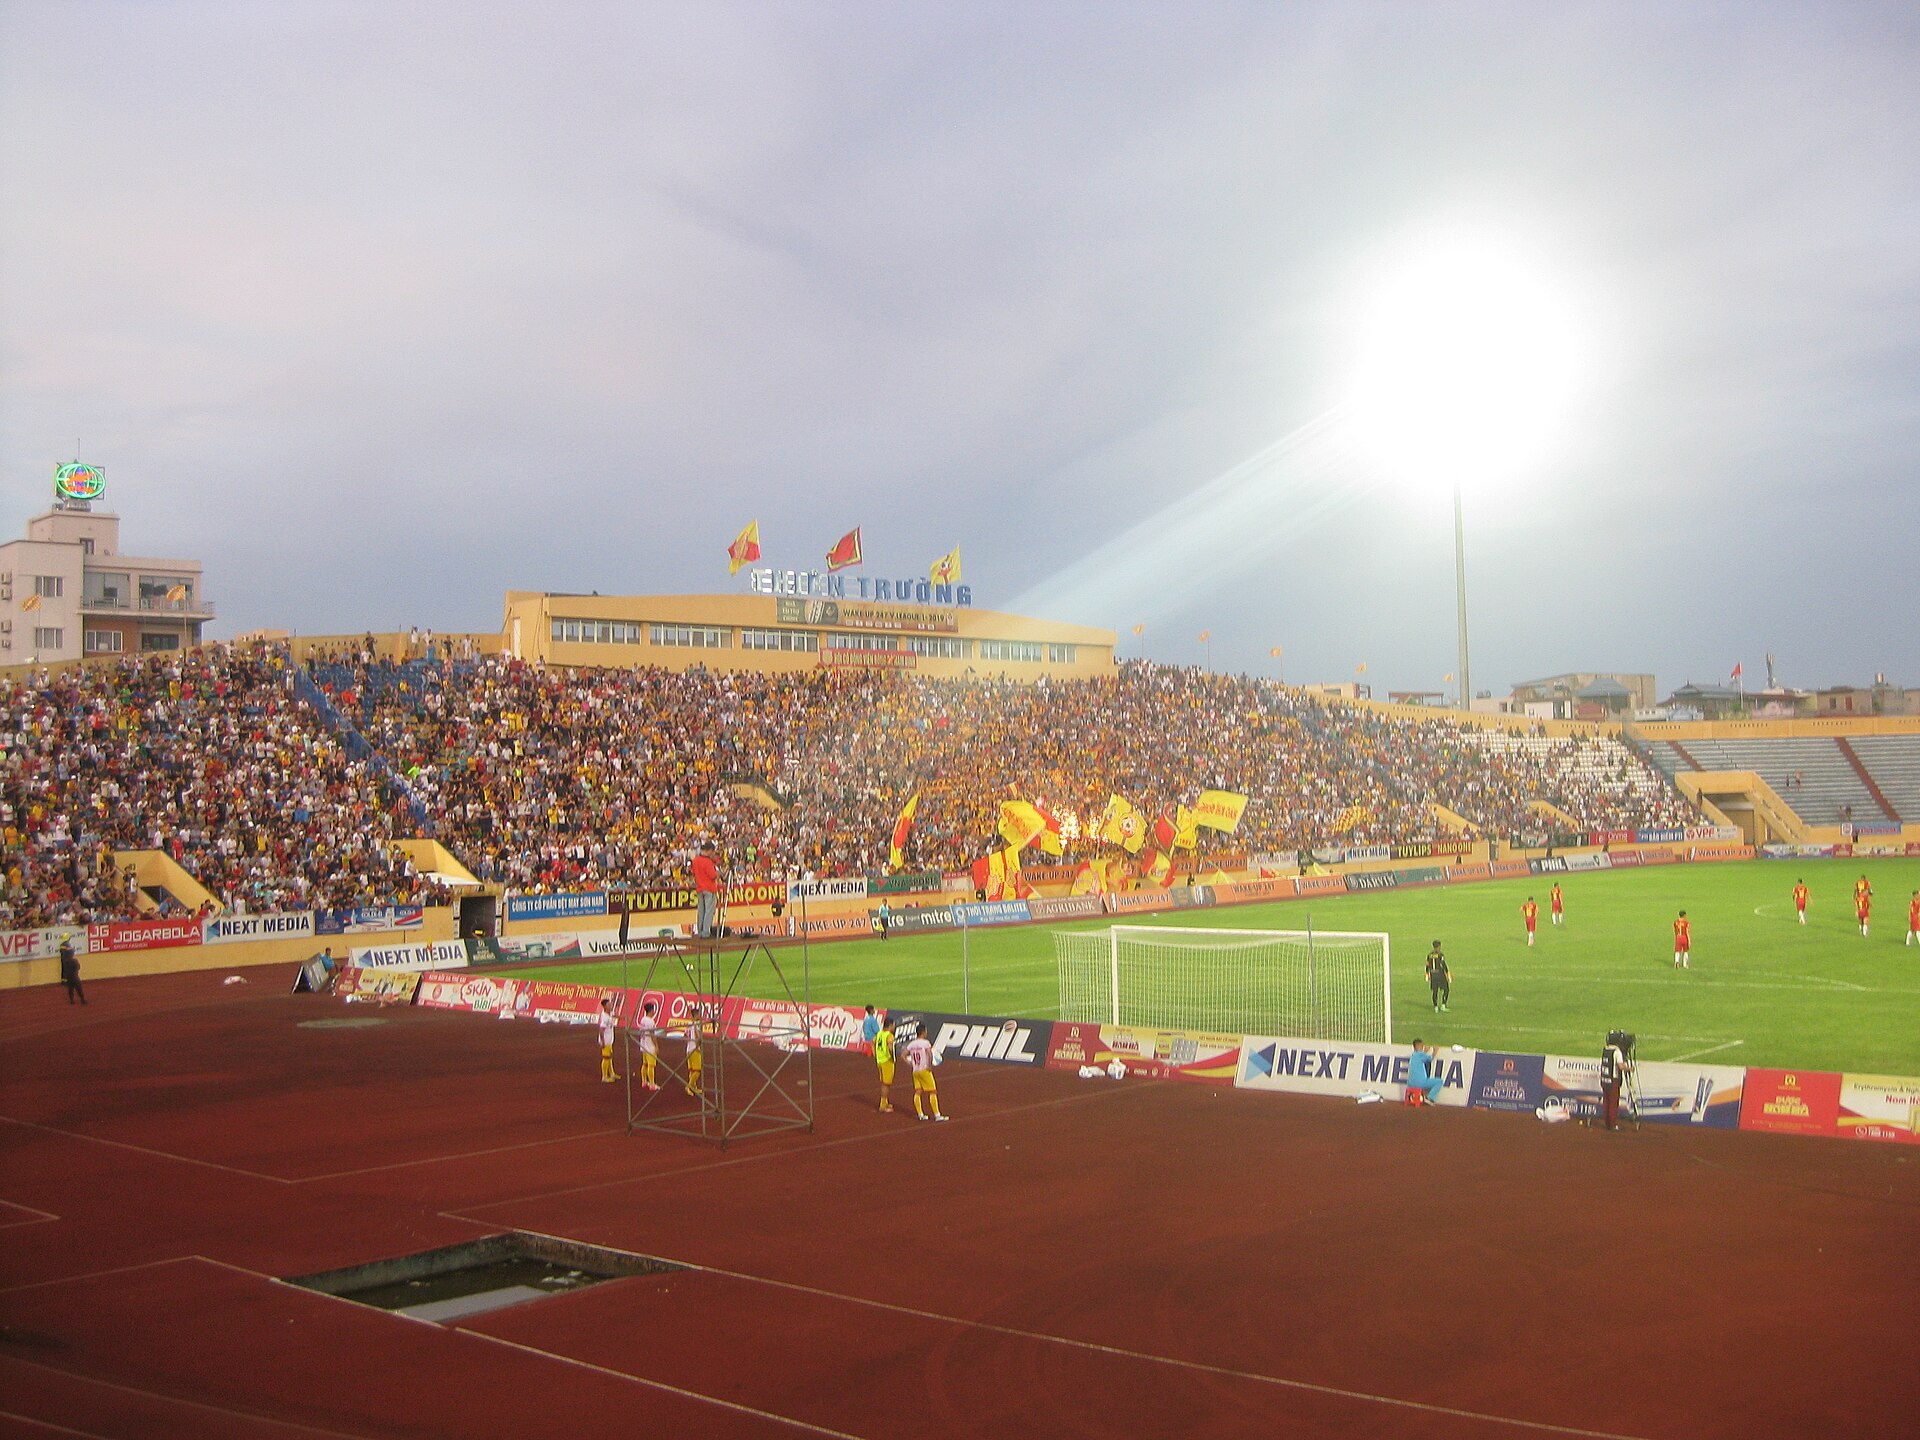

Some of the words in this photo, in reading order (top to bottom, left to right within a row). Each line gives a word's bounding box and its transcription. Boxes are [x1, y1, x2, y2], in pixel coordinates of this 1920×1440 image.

[801, 881, 827, 896] NEXT
[830, 880, 865, 895] MEDIA
[626, 890, 699, 911] TUYLIPS
[757, 884, 786, 902] ONE
[222, 920, 260, 936] NEXT
[263, 916, 310, 933] MEDIA
[850, 917, 866, 929] 247
[872, 911, 905, 930] mtre
[921, 909, 952, 926] mitre
[90, 925, 110, 938] JG
[113, 926, 201, 943] JOGARBOLA
[0, 932, 40, 956] VPF
[90, 940, 110, 952] BL
[374, 949, 411, 967] NEXT
[416, 945, 464, 963] MEDIA
[1277, 1048, 1354, 1081] NEXT
[1361, 1054, 1464, 1089] MEIA
